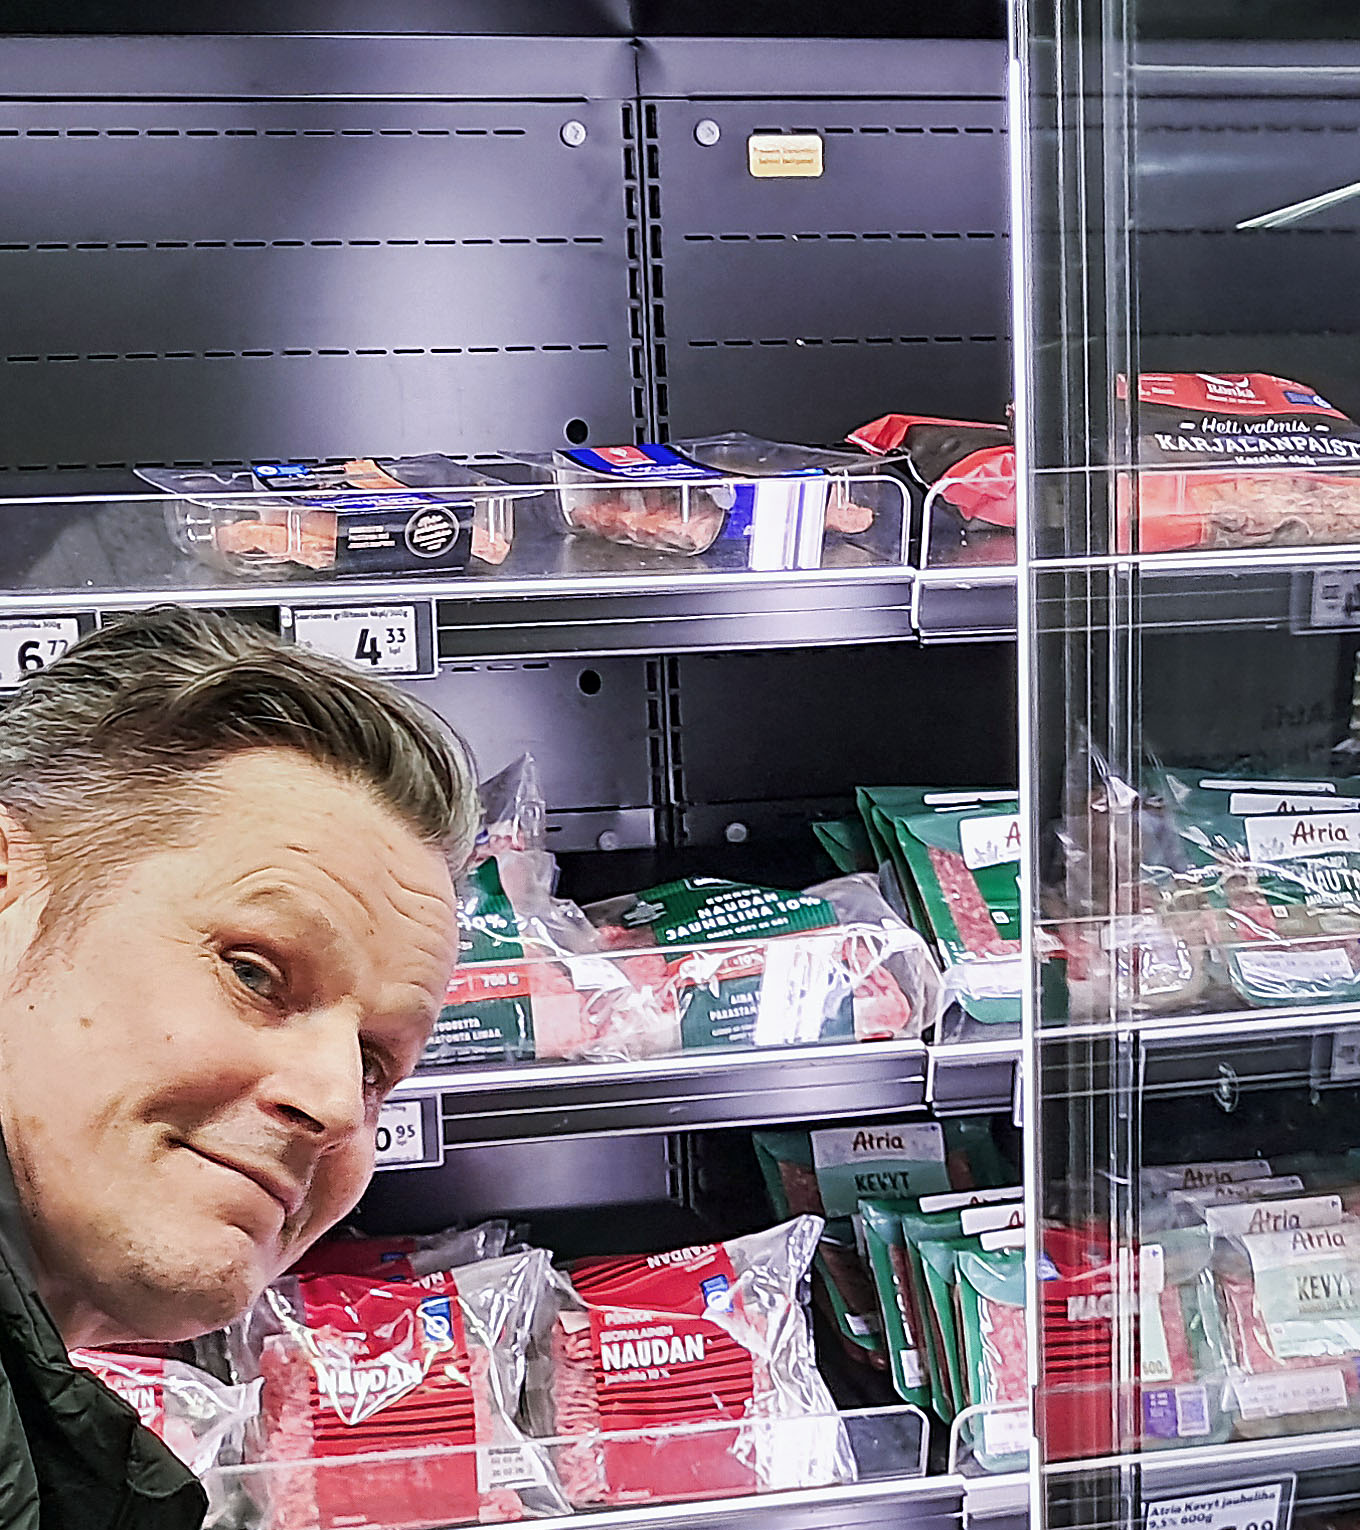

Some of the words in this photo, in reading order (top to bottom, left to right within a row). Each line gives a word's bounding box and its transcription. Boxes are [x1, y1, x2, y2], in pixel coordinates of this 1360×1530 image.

[1244, 417, 1311, 433] valmis
[18, 640, 45, 672] 6
[355, 628, 382, 666] 4
[385, 627, 407, 644] 33
[1292, 820, 1350, 846] Atria
[665, 905, 767, 942] JAUHELIHA
[768, 894, 822, 919] 10%
[698, 891, 780, 920] NAUDAN
[395, 1124, 416, 1138] 95
[852, 1131, 905, 1152] Atria
[854, 1171, 910, 1193] KEVYT
[1183, 1167, 1234, 1189] Atria
[1247, 1207, 1301, 1235] Atria
[1291, 1230, 1346, 1251] Atria
[1295, 1273, 1353, 1302] KEVY
[599, 1333, 706, 1372] NAUDAN
